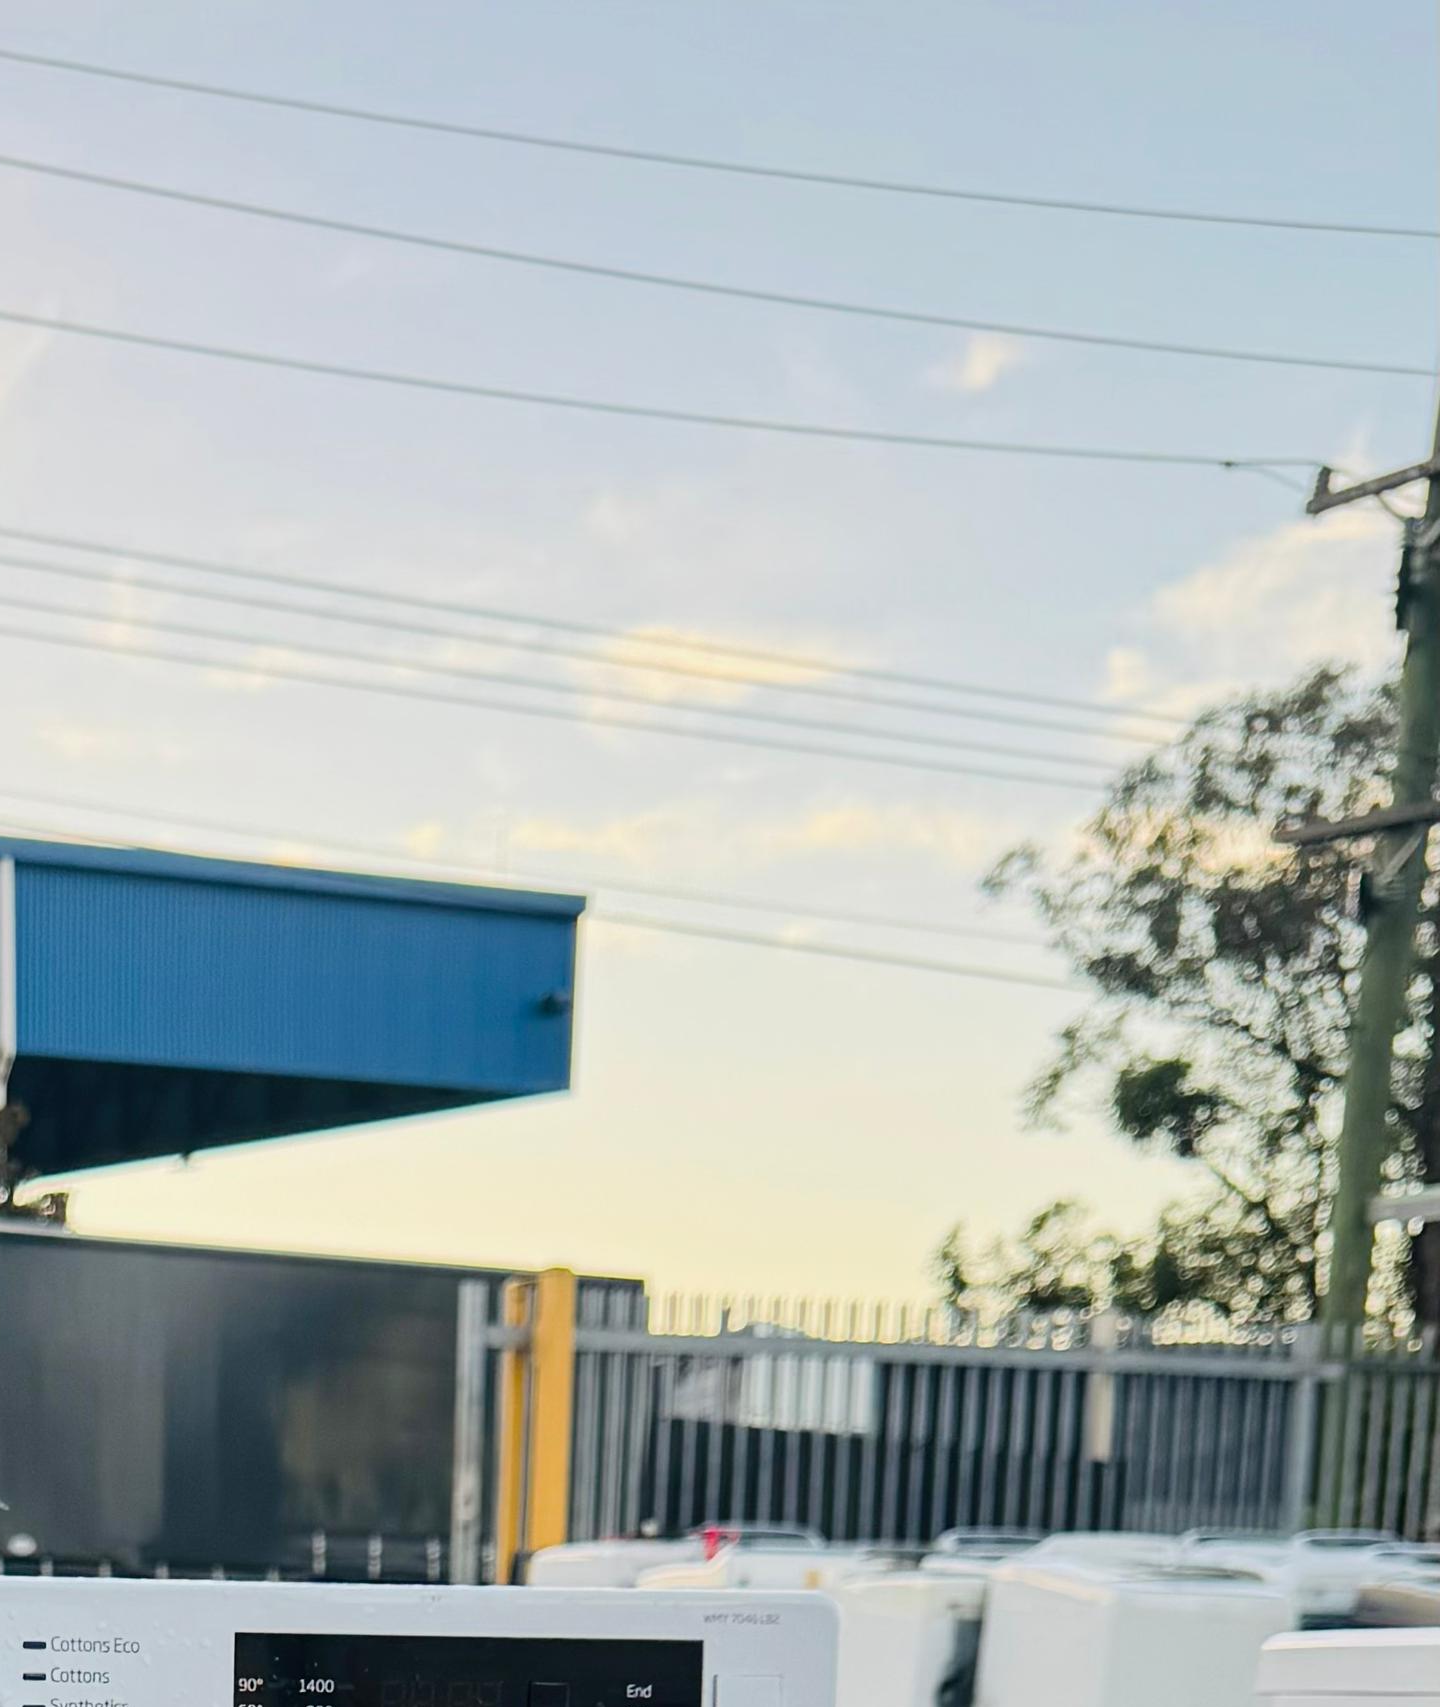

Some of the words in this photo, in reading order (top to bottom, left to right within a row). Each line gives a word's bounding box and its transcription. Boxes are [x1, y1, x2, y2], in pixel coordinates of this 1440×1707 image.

[51, 1637, 110, 1653] Cottons
[114, 1637, 140, 1654] Eco
[51, 1668, 110, 1684] Cottons
[299, 1679, 335, 1693] 1400
[626, 1684, 653, 1698] End
